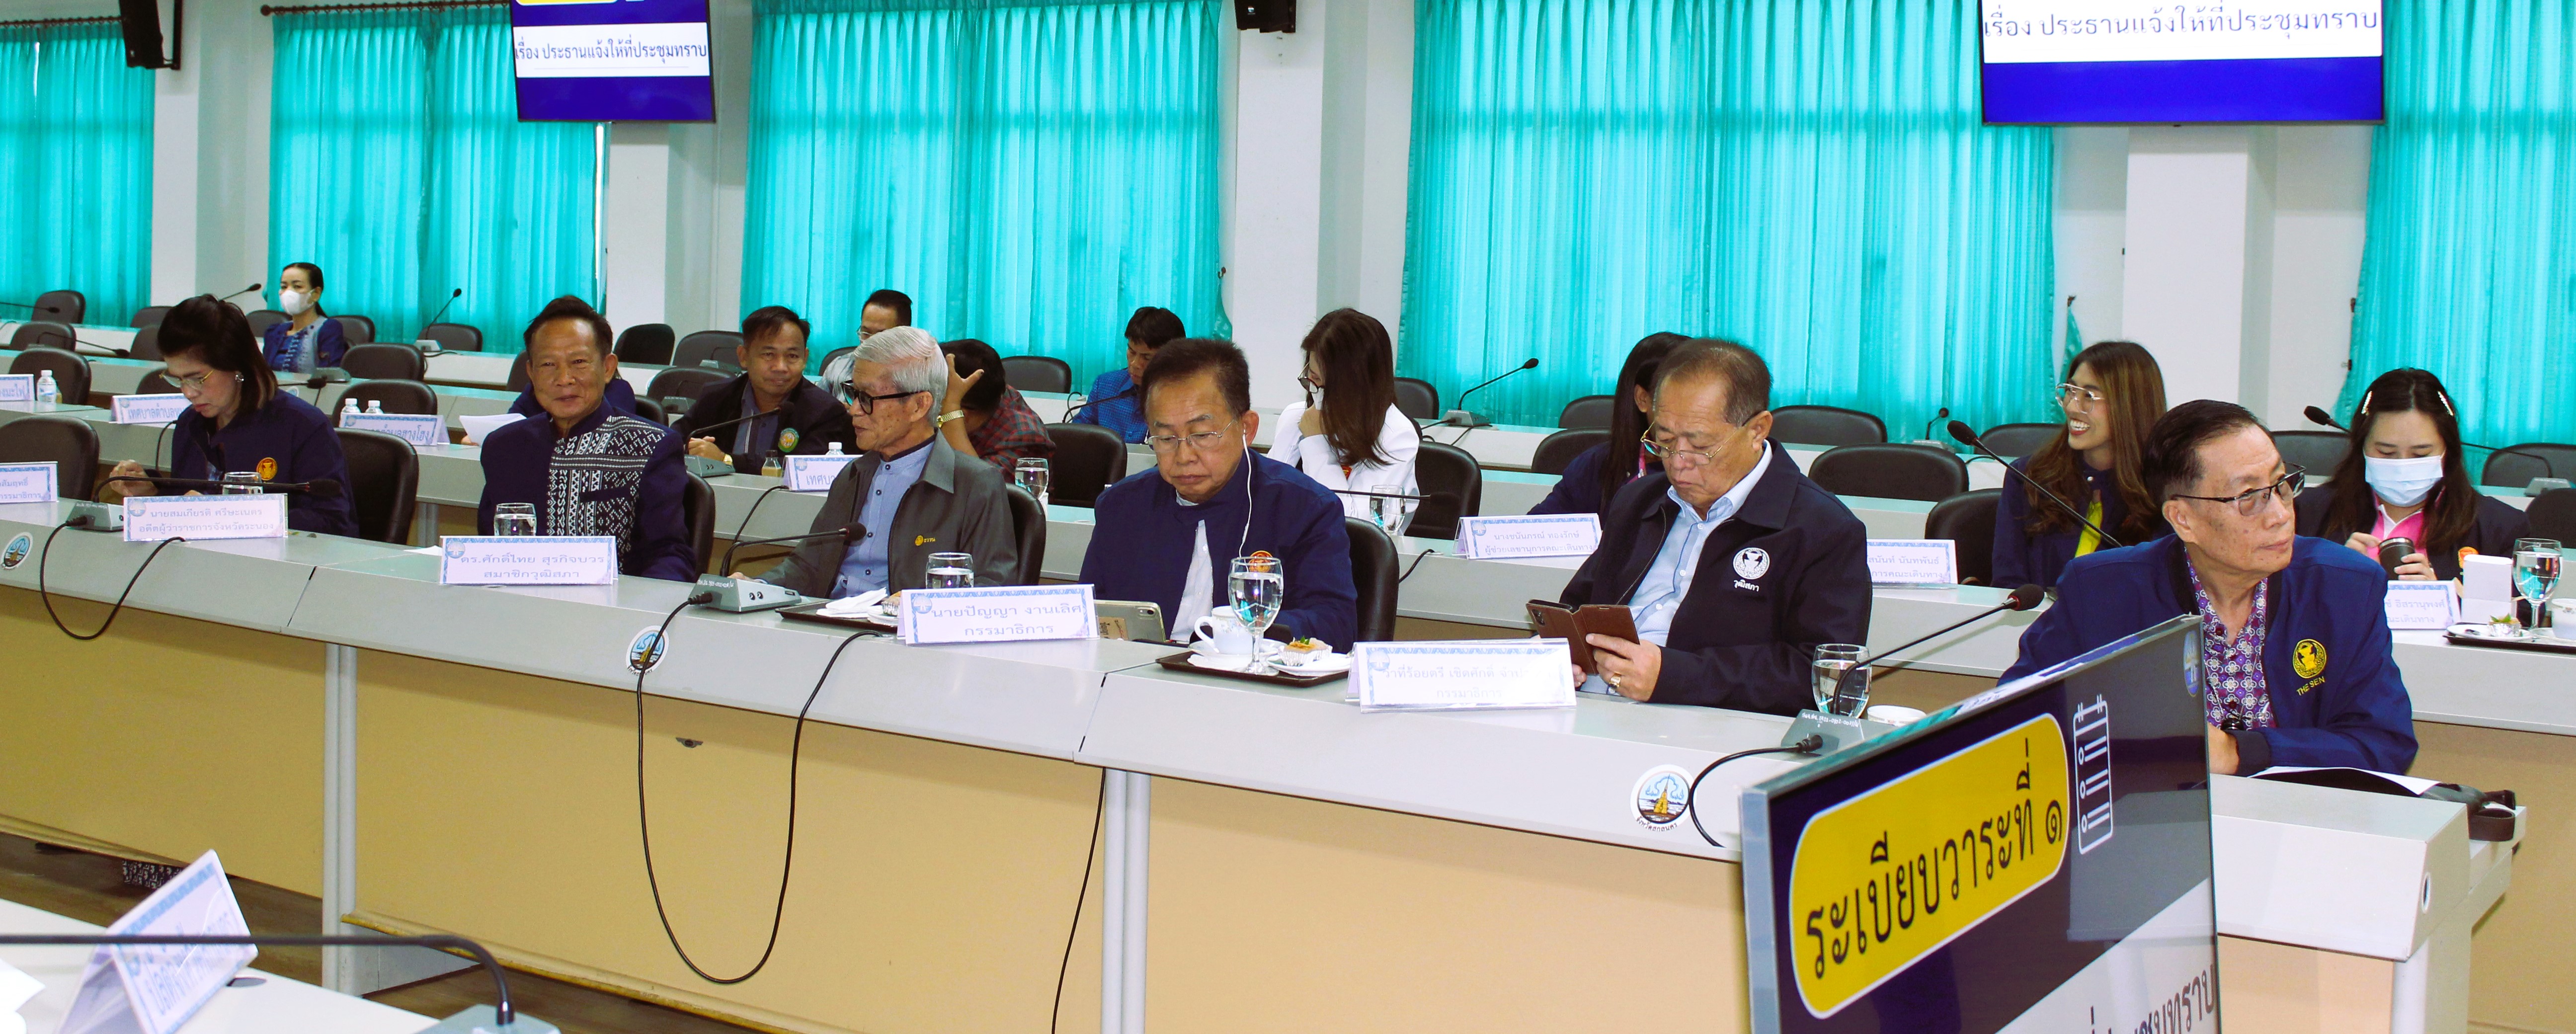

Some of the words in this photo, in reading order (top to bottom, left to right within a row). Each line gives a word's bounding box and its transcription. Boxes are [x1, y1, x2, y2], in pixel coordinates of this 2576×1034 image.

[1985, 4, 2030, 37] เรื่อง
[2039, 0, 2377, 39] ประธานแจ้งให้ที่ประชุมทราบ
[515, 37, 539, 60] เรื่อง
[543, 35, 707, 64] ประธานแจ้งให้ที่ประชุมทราบ
[151, 508, 211, 517] นายสมเกียรติ
[461, 552, 536, 564] ดร.ศักดิ์ไทย
[484, 568, 580, 581] สมาชิกวุฒิสภา
[1734, 579, 1760, 592] วุฒิสภา
[932, 603, 1017, 620] นายปัญญา
[1024, 602, 1082, 615] งานเลิศ
[964, 623, 1054, 637] กรรมาธิการ
[1383, 664, 1444, 679] ว่าที่ร้อยตรี
[1449, 664, 1495, 678] เชิดศักดิ์
[1437, 687, 1503, 699] กรรมาธิการ
[2296, 683, 2310, 696] THE
[2309, 676, 2325, 688] SEN
[1807, 737, 2035, 979] ระเบียบวาระที่
